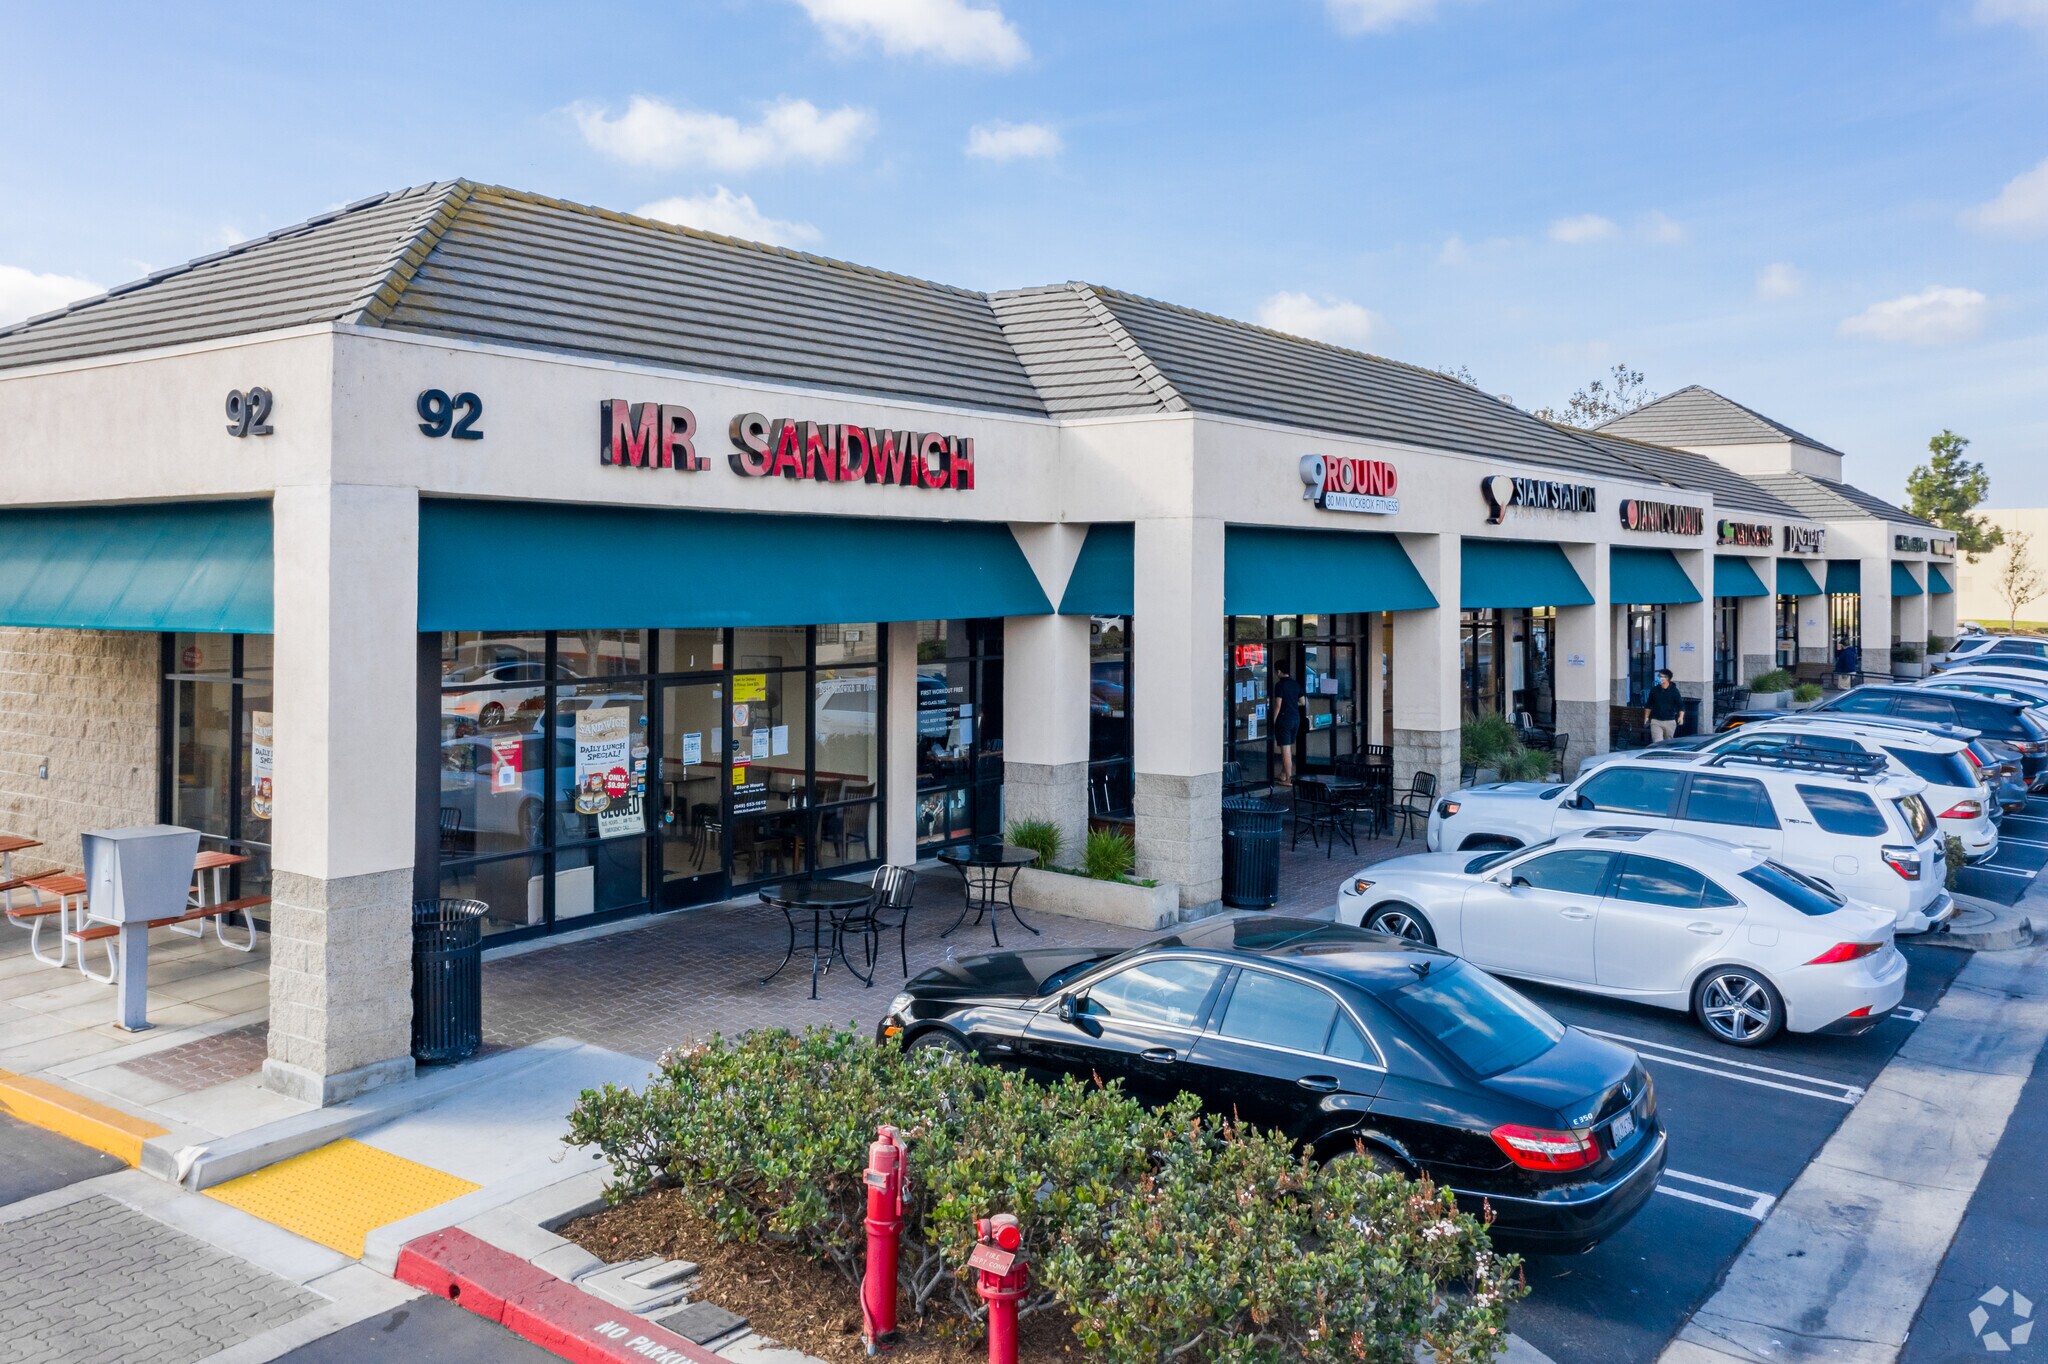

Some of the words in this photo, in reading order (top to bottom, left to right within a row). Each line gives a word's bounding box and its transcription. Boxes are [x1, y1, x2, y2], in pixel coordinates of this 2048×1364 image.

[225, 386, 274, 438] 92
[416, 388, 484, 440] 92
[600, 398, 711, 472] MR.
[727, 411, 975, 490] SANDWICH
[1327, 494, 1334, 507] 30
[1335, 496, 1348, 508] MIN
[1348, 497, 1375, 509] KICKBOX
[1375, 498, 1398, 512] FITNESS
[1513, 477, 1549, 508] SIAM
[1551, 481, 1596, 512] STATION
[1673, 504, 1704, 536] DONUTS
[1235, 644, 1264, 668] OPEN
[932, 687, 953, 695] WORKOUT
[579, 716, 627, 736] SANDWICH
[255, 747, 270, 757] DAILY
[580, 744, 602, 754] DAILY
[602, 742, 626, 751] LUNCH
[587, 749, 621, 761] SPECIAL!
[1572, 1118, 1579, 1126] E
[1579, 1112, 1593, 1124] 350
[971, 1255, 987, 1265] DEPT
[988, 1261, 1007, 1271] CONN
[985, 1251, 1001, 1261] FIRE
[594, 1320, 629, 1339] NO
